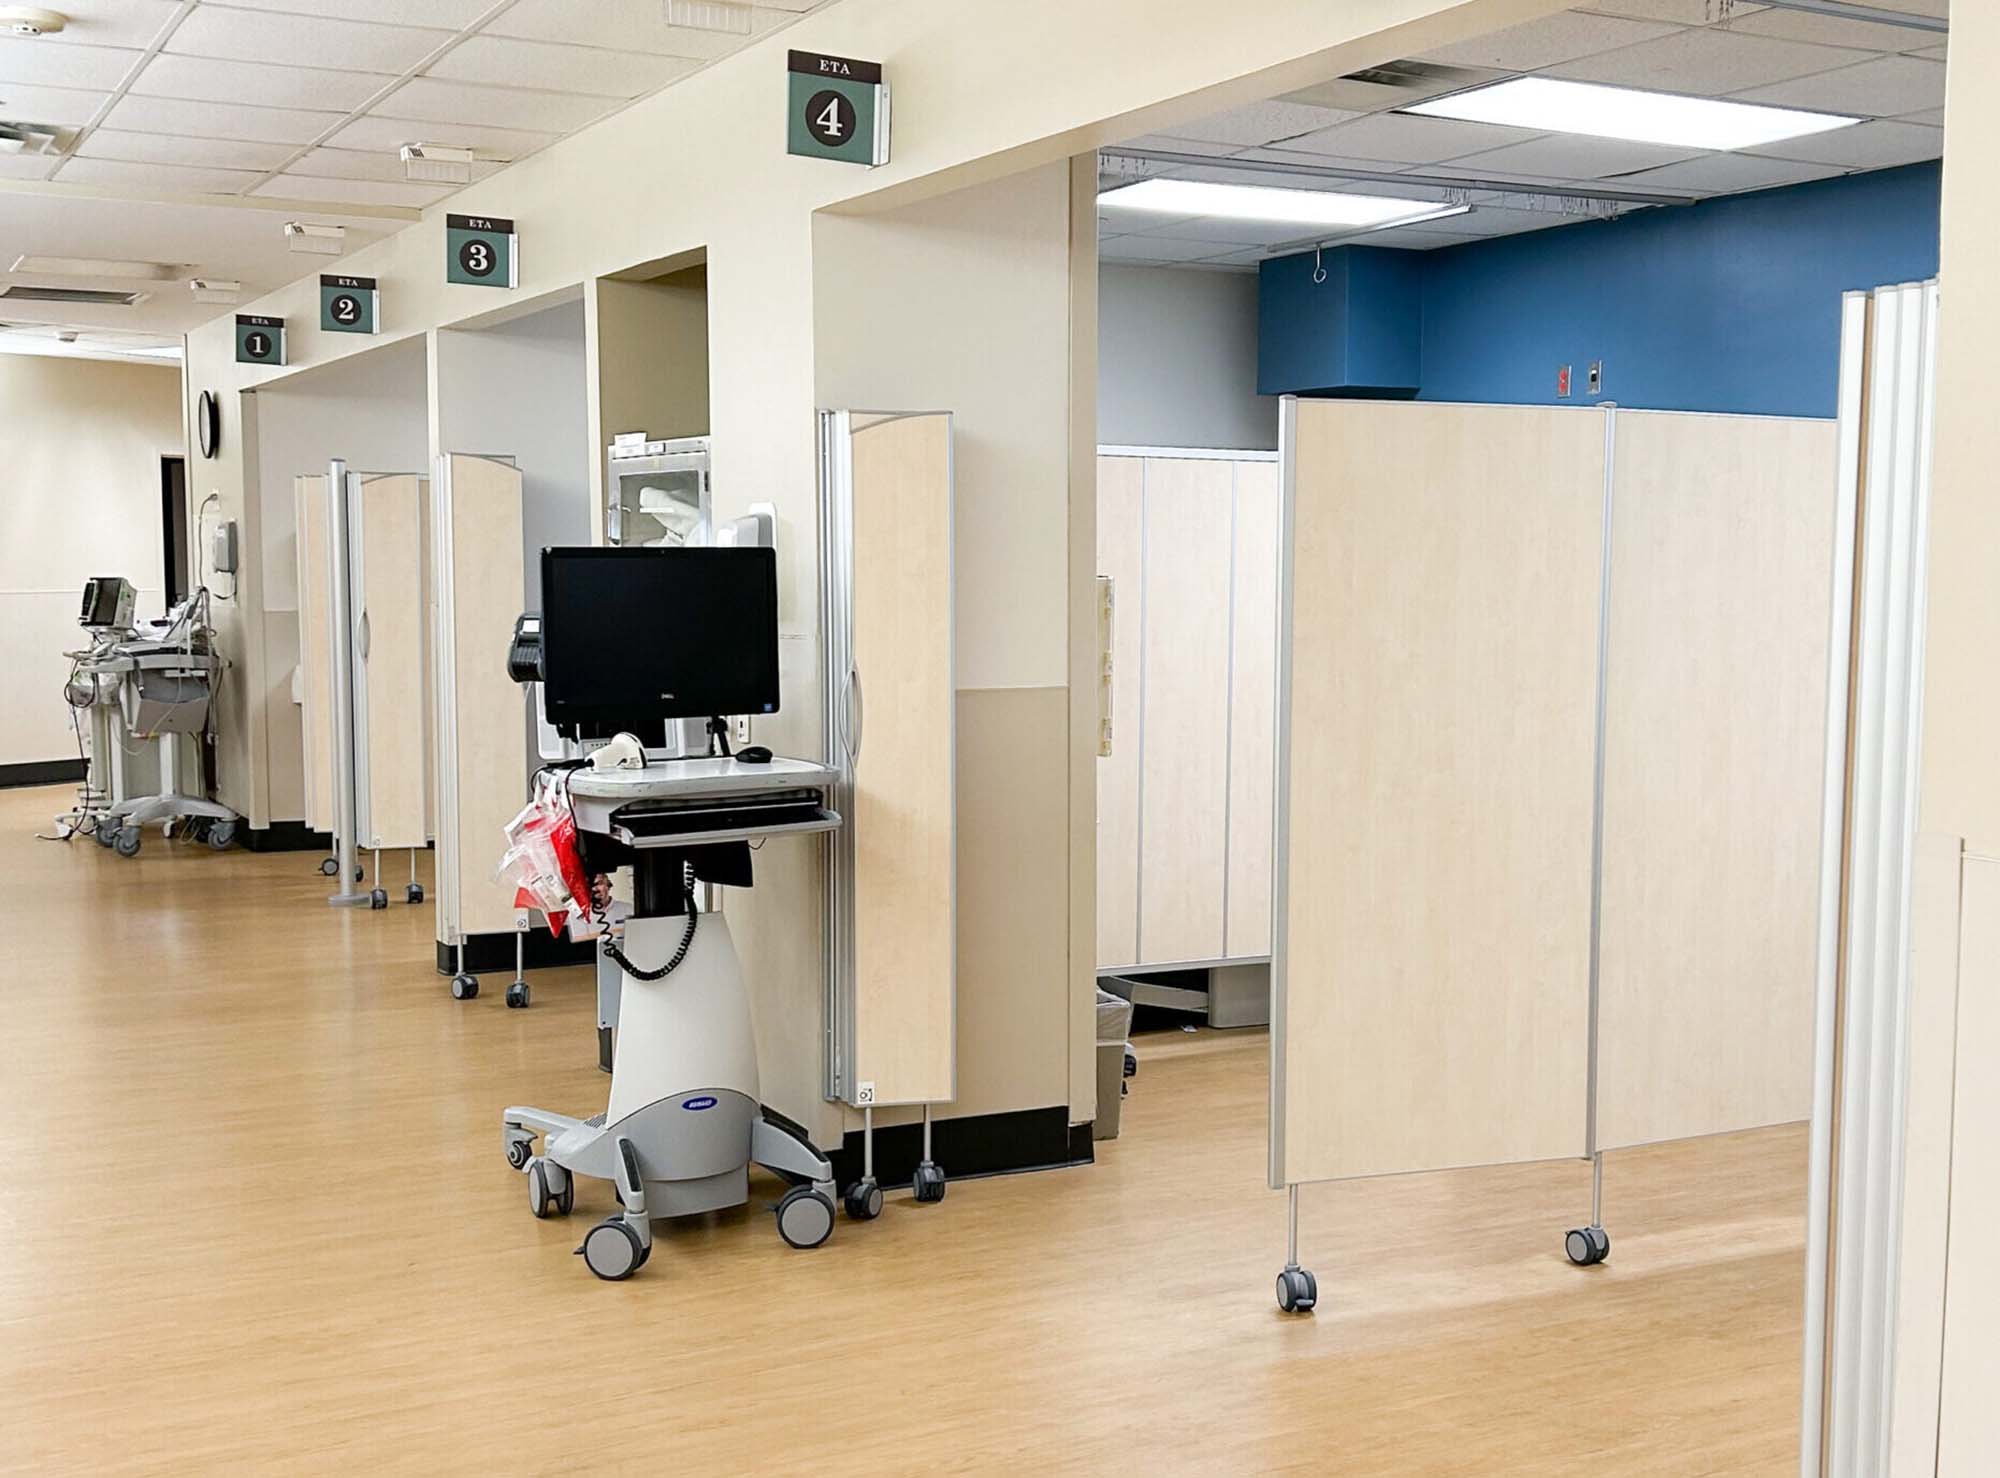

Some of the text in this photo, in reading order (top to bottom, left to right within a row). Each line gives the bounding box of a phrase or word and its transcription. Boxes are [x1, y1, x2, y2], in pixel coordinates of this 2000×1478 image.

[820, 59, 851, 75] ETA
[816, 97, 843, 136] 4
[469, 219, 492, 229] ETA
[469, 244, 488, 271] 3
[338, 278, 358, 287] ETA
[338, 298, 354, 320] 2
[252, 335, 264, 353] 1
